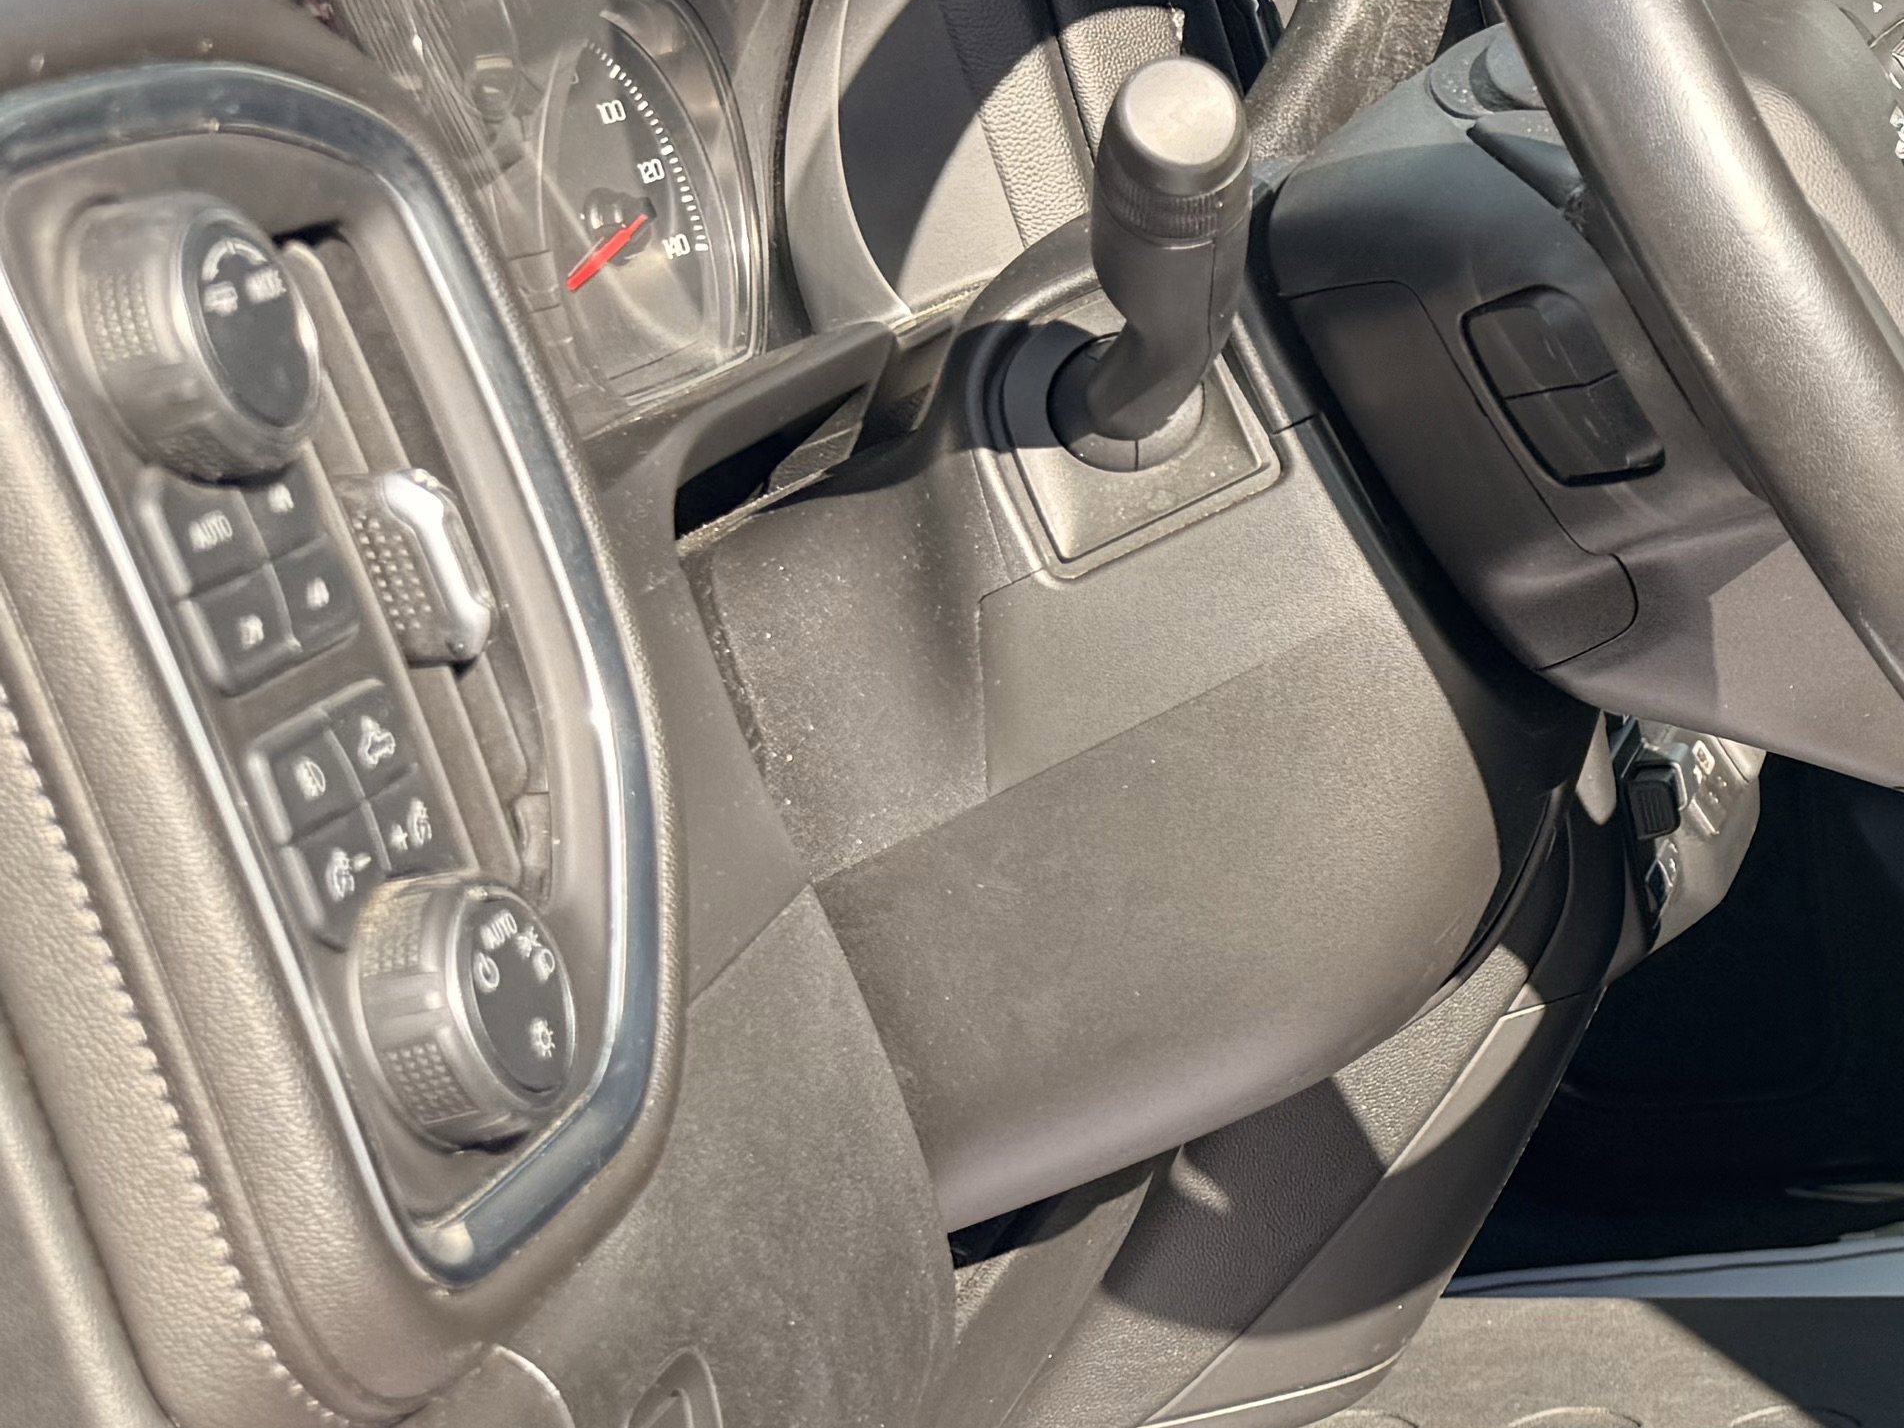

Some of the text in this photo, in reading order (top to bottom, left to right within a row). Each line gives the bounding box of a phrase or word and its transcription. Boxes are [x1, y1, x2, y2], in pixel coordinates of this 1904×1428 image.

[597, 100, 626, 124] 100
[637, 158, 665, 184] 120
[662, 233, 690, 259] 140
[188, 510, 233, 545] AUTO
[481, 909, 518, 950] AUTO
